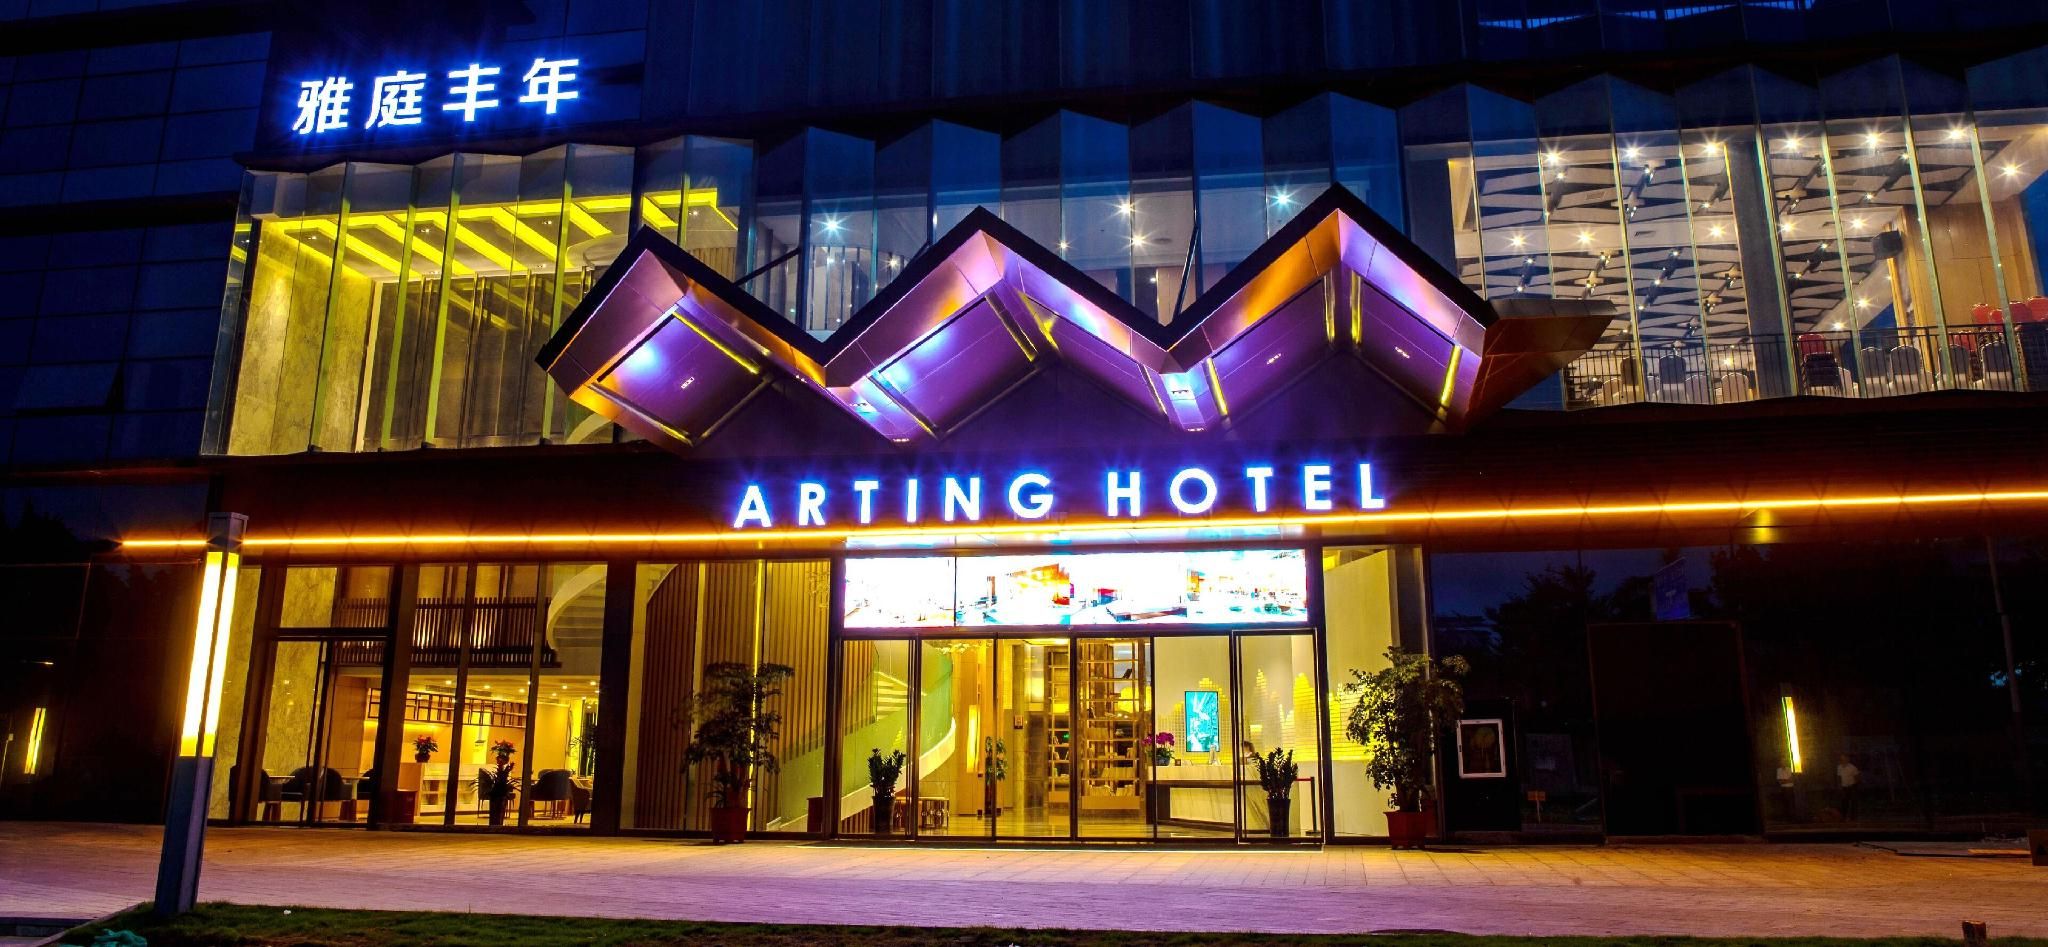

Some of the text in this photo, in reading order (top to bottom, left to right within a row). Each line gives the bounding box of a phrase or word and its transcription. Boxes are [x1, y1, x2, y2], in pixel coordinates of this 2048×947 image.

[292, 58, 580, 135] 雅庭丰年
[733, 463, 1386, 529] ARTING HOTEL
